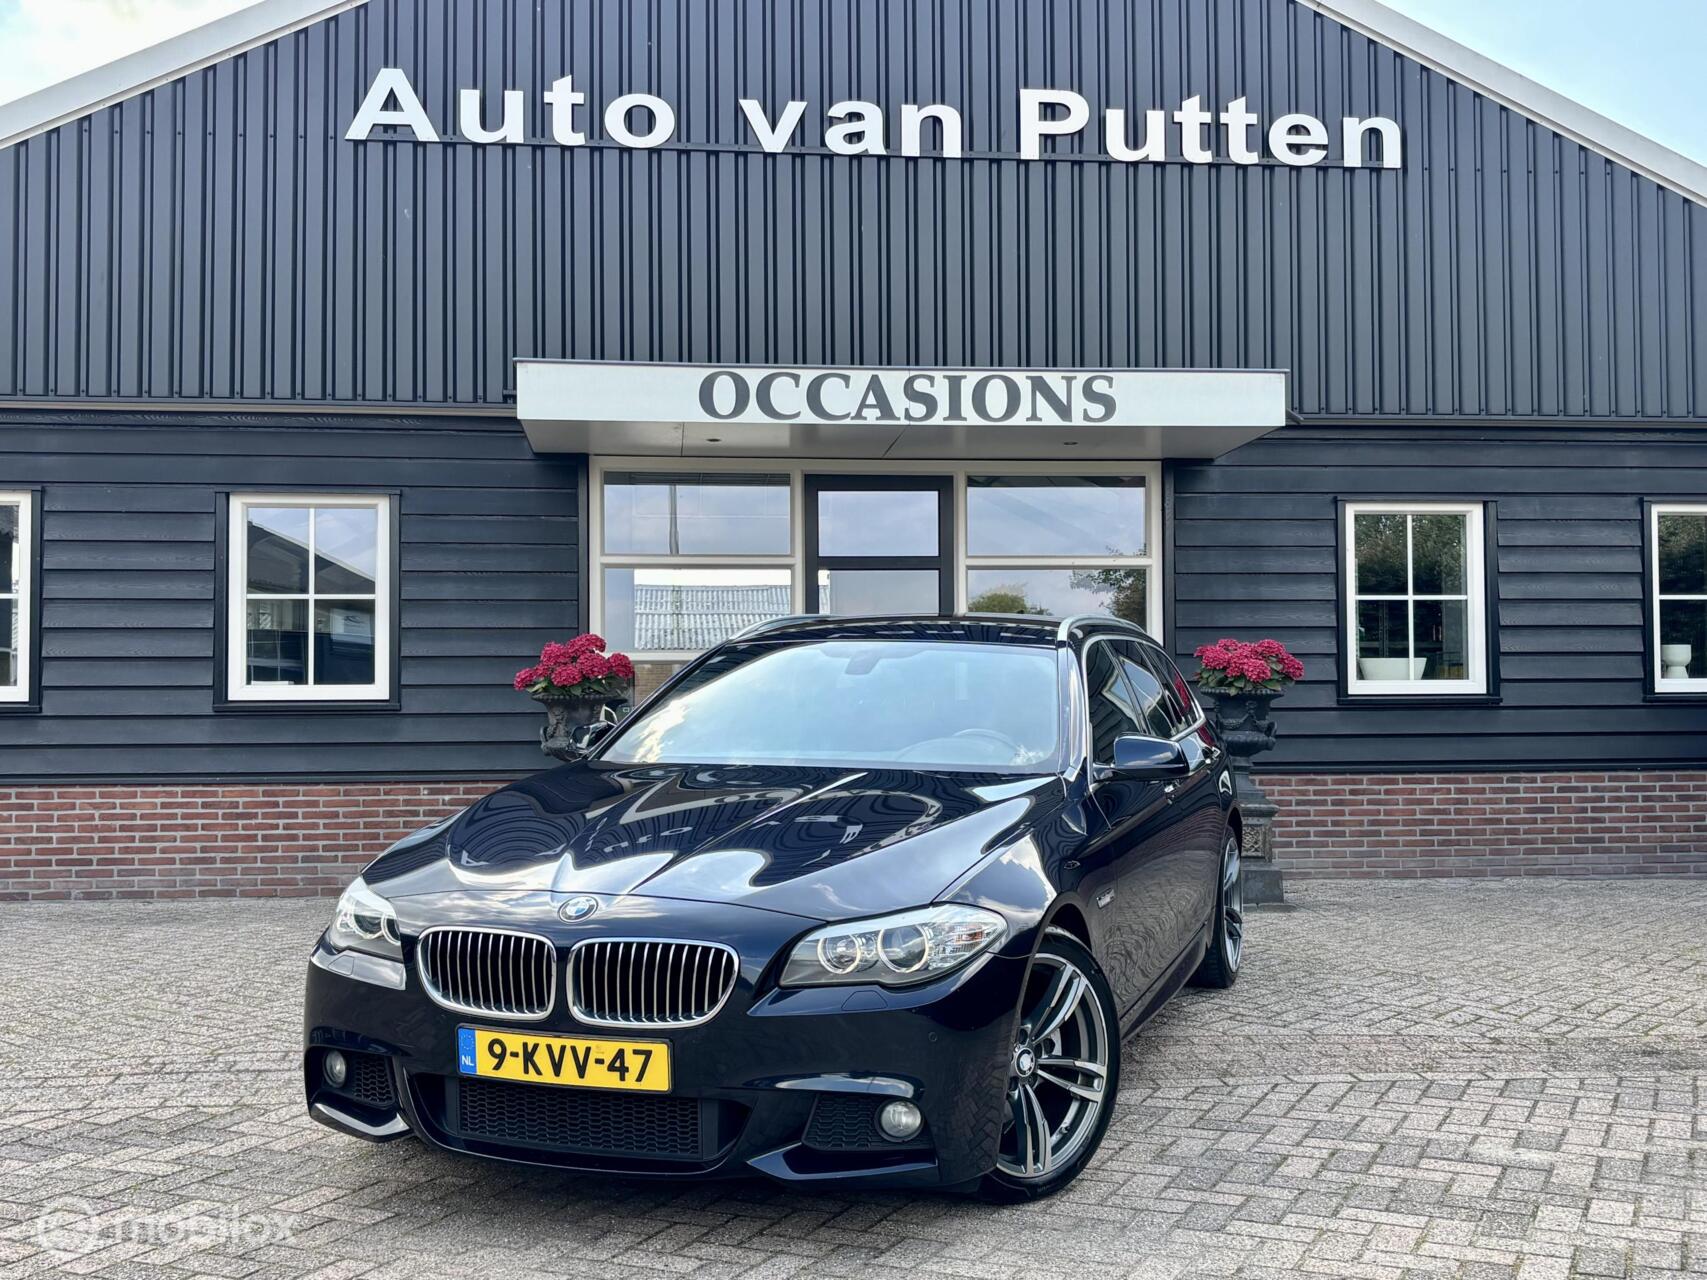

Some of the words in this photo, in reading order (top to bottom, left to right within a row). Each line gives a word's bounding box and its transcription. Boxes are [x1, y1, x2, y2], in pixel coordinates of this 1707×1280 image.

[345, 68, 675, 149] Auto
[739, 99, 962, 158] van
[1019, 88, 1402, 169] Putten
[699, 371, 1116, 423] OCCASIONS
[461, 1055, 475, 1067] NL
[487, 1038, 653, 1083] 9-KVV-47
